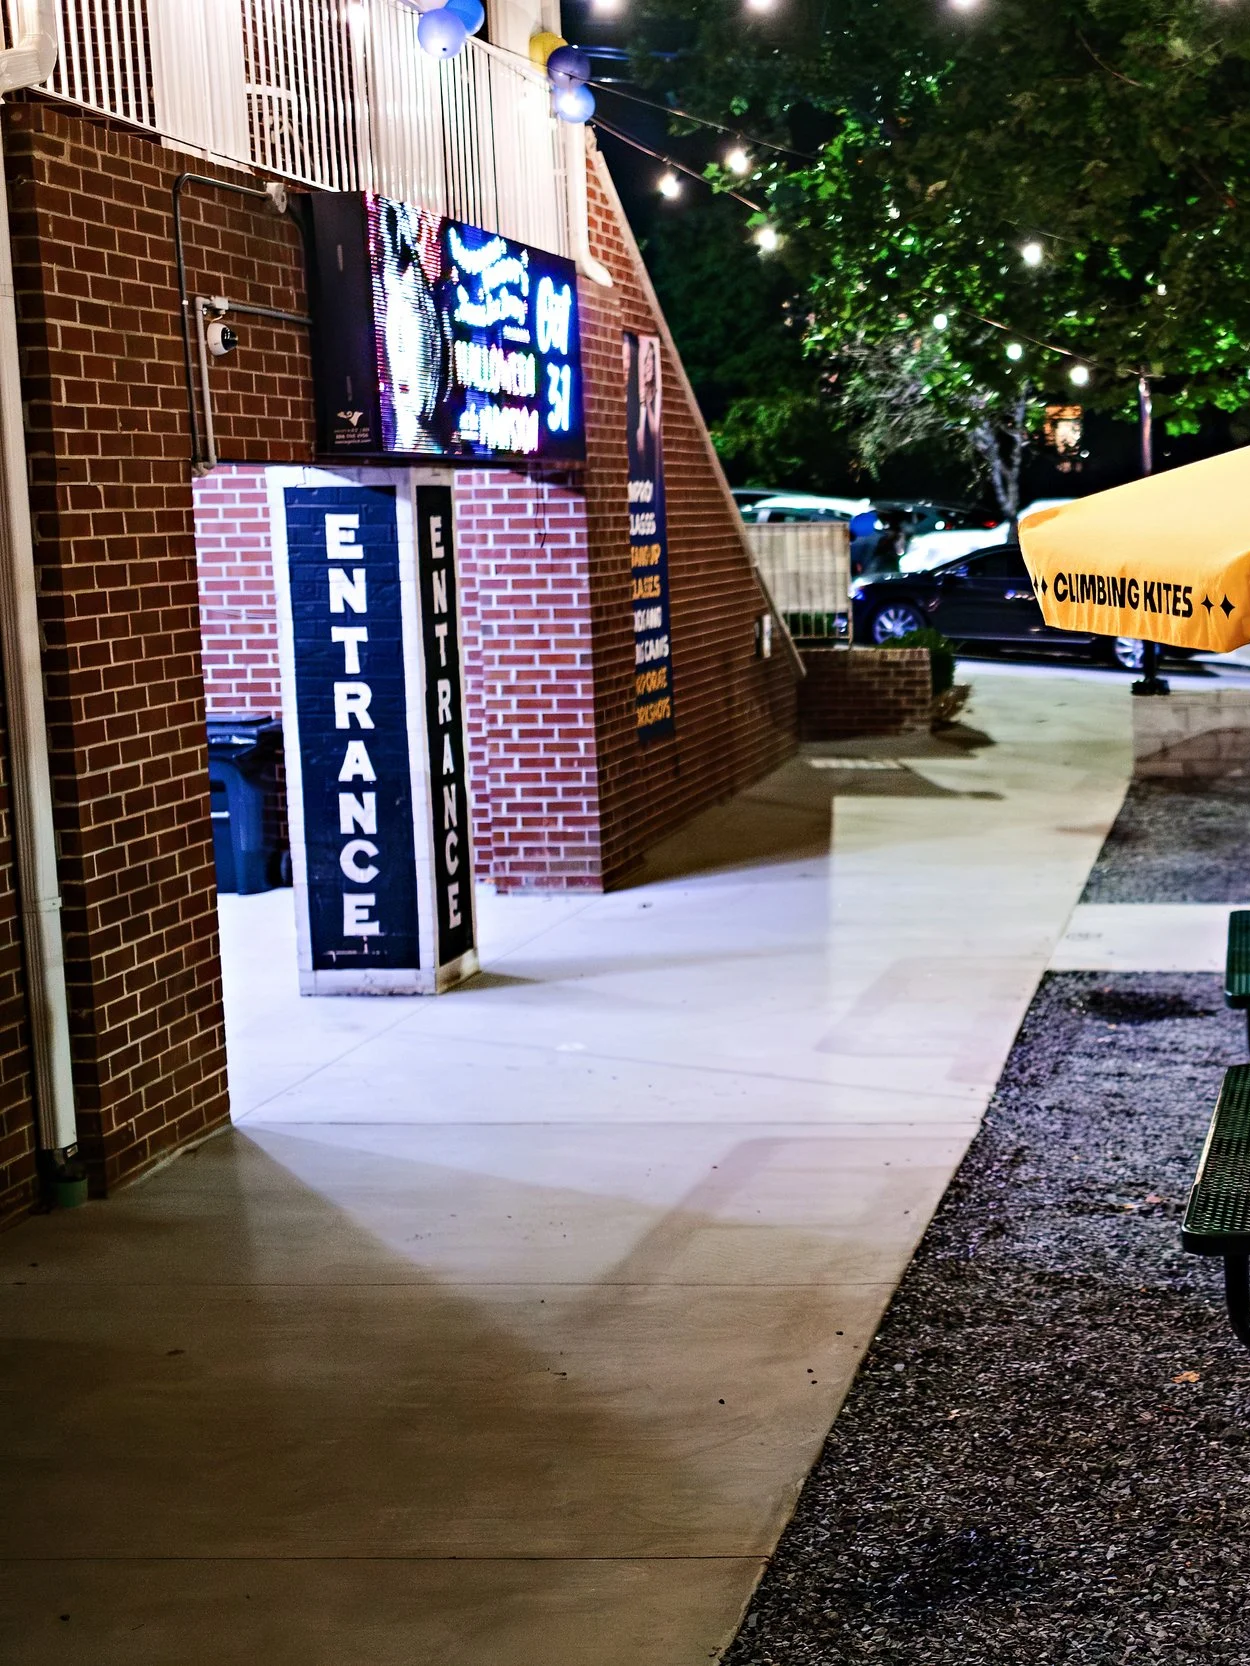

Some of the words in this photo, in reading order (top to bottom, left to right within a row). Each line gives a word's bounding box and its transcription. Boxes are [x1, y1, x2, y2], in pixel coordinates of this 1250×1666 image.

[547, 362, 571, 431] 31
[1054, 572, 1140, 610] CLIMBING
[1143, 580, 1193, 618] KITES
[325, 513, 380, 936] ENTRANCE
[429, 515, 462, 930] ENTRANCE
